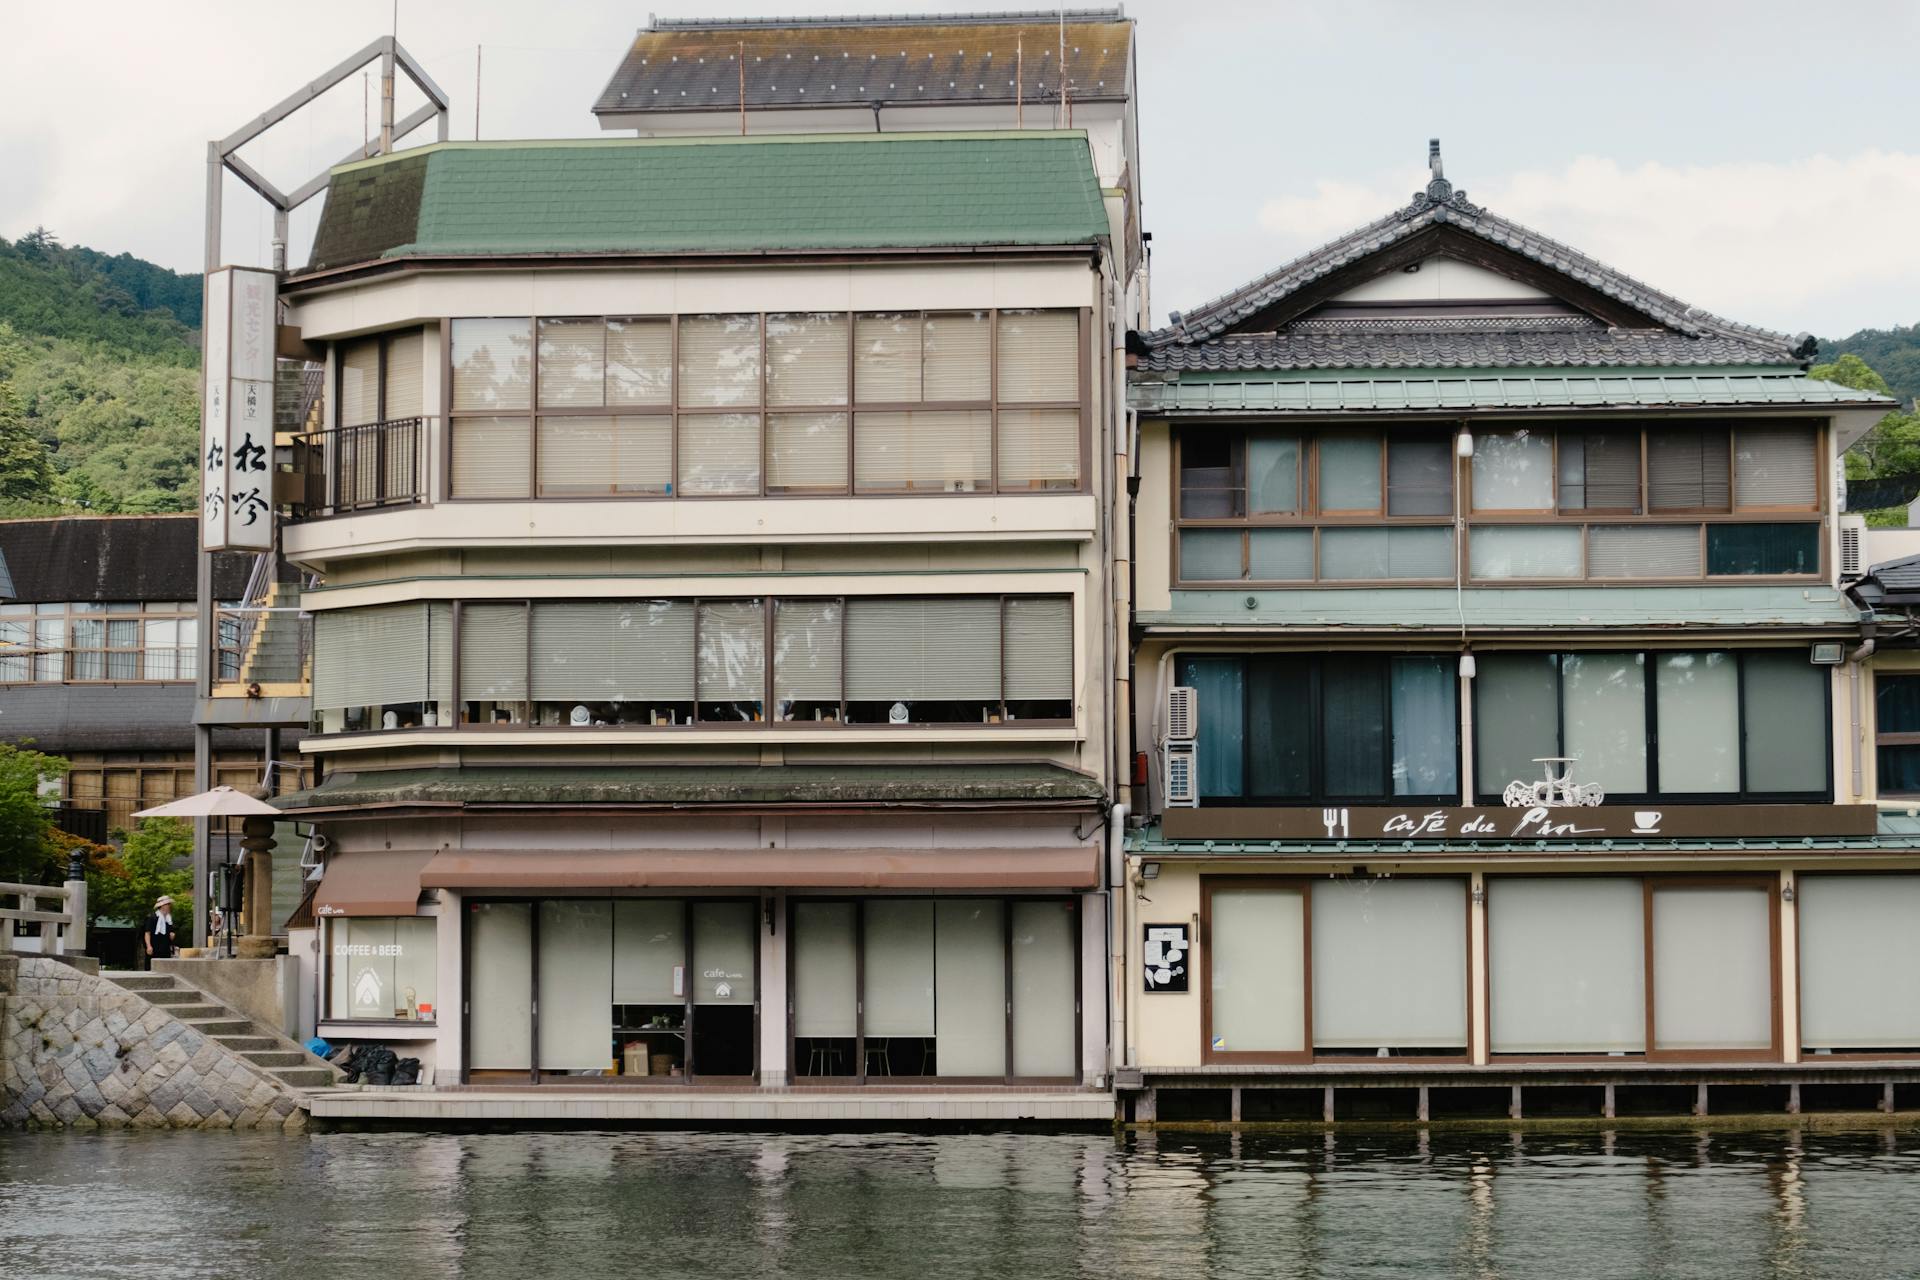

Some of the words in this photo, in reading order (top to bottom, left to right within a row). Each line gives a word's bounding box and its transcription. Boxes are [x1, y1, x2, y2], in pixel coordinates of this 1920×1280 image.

[247, 384, 257, 418] 天橋立
[1460, 815, 1496, 834] du
[334, 944, 371, 956] COFFEE
[378, 944, 403, 956] BEER
[703, 968, 725, 978] cafe
